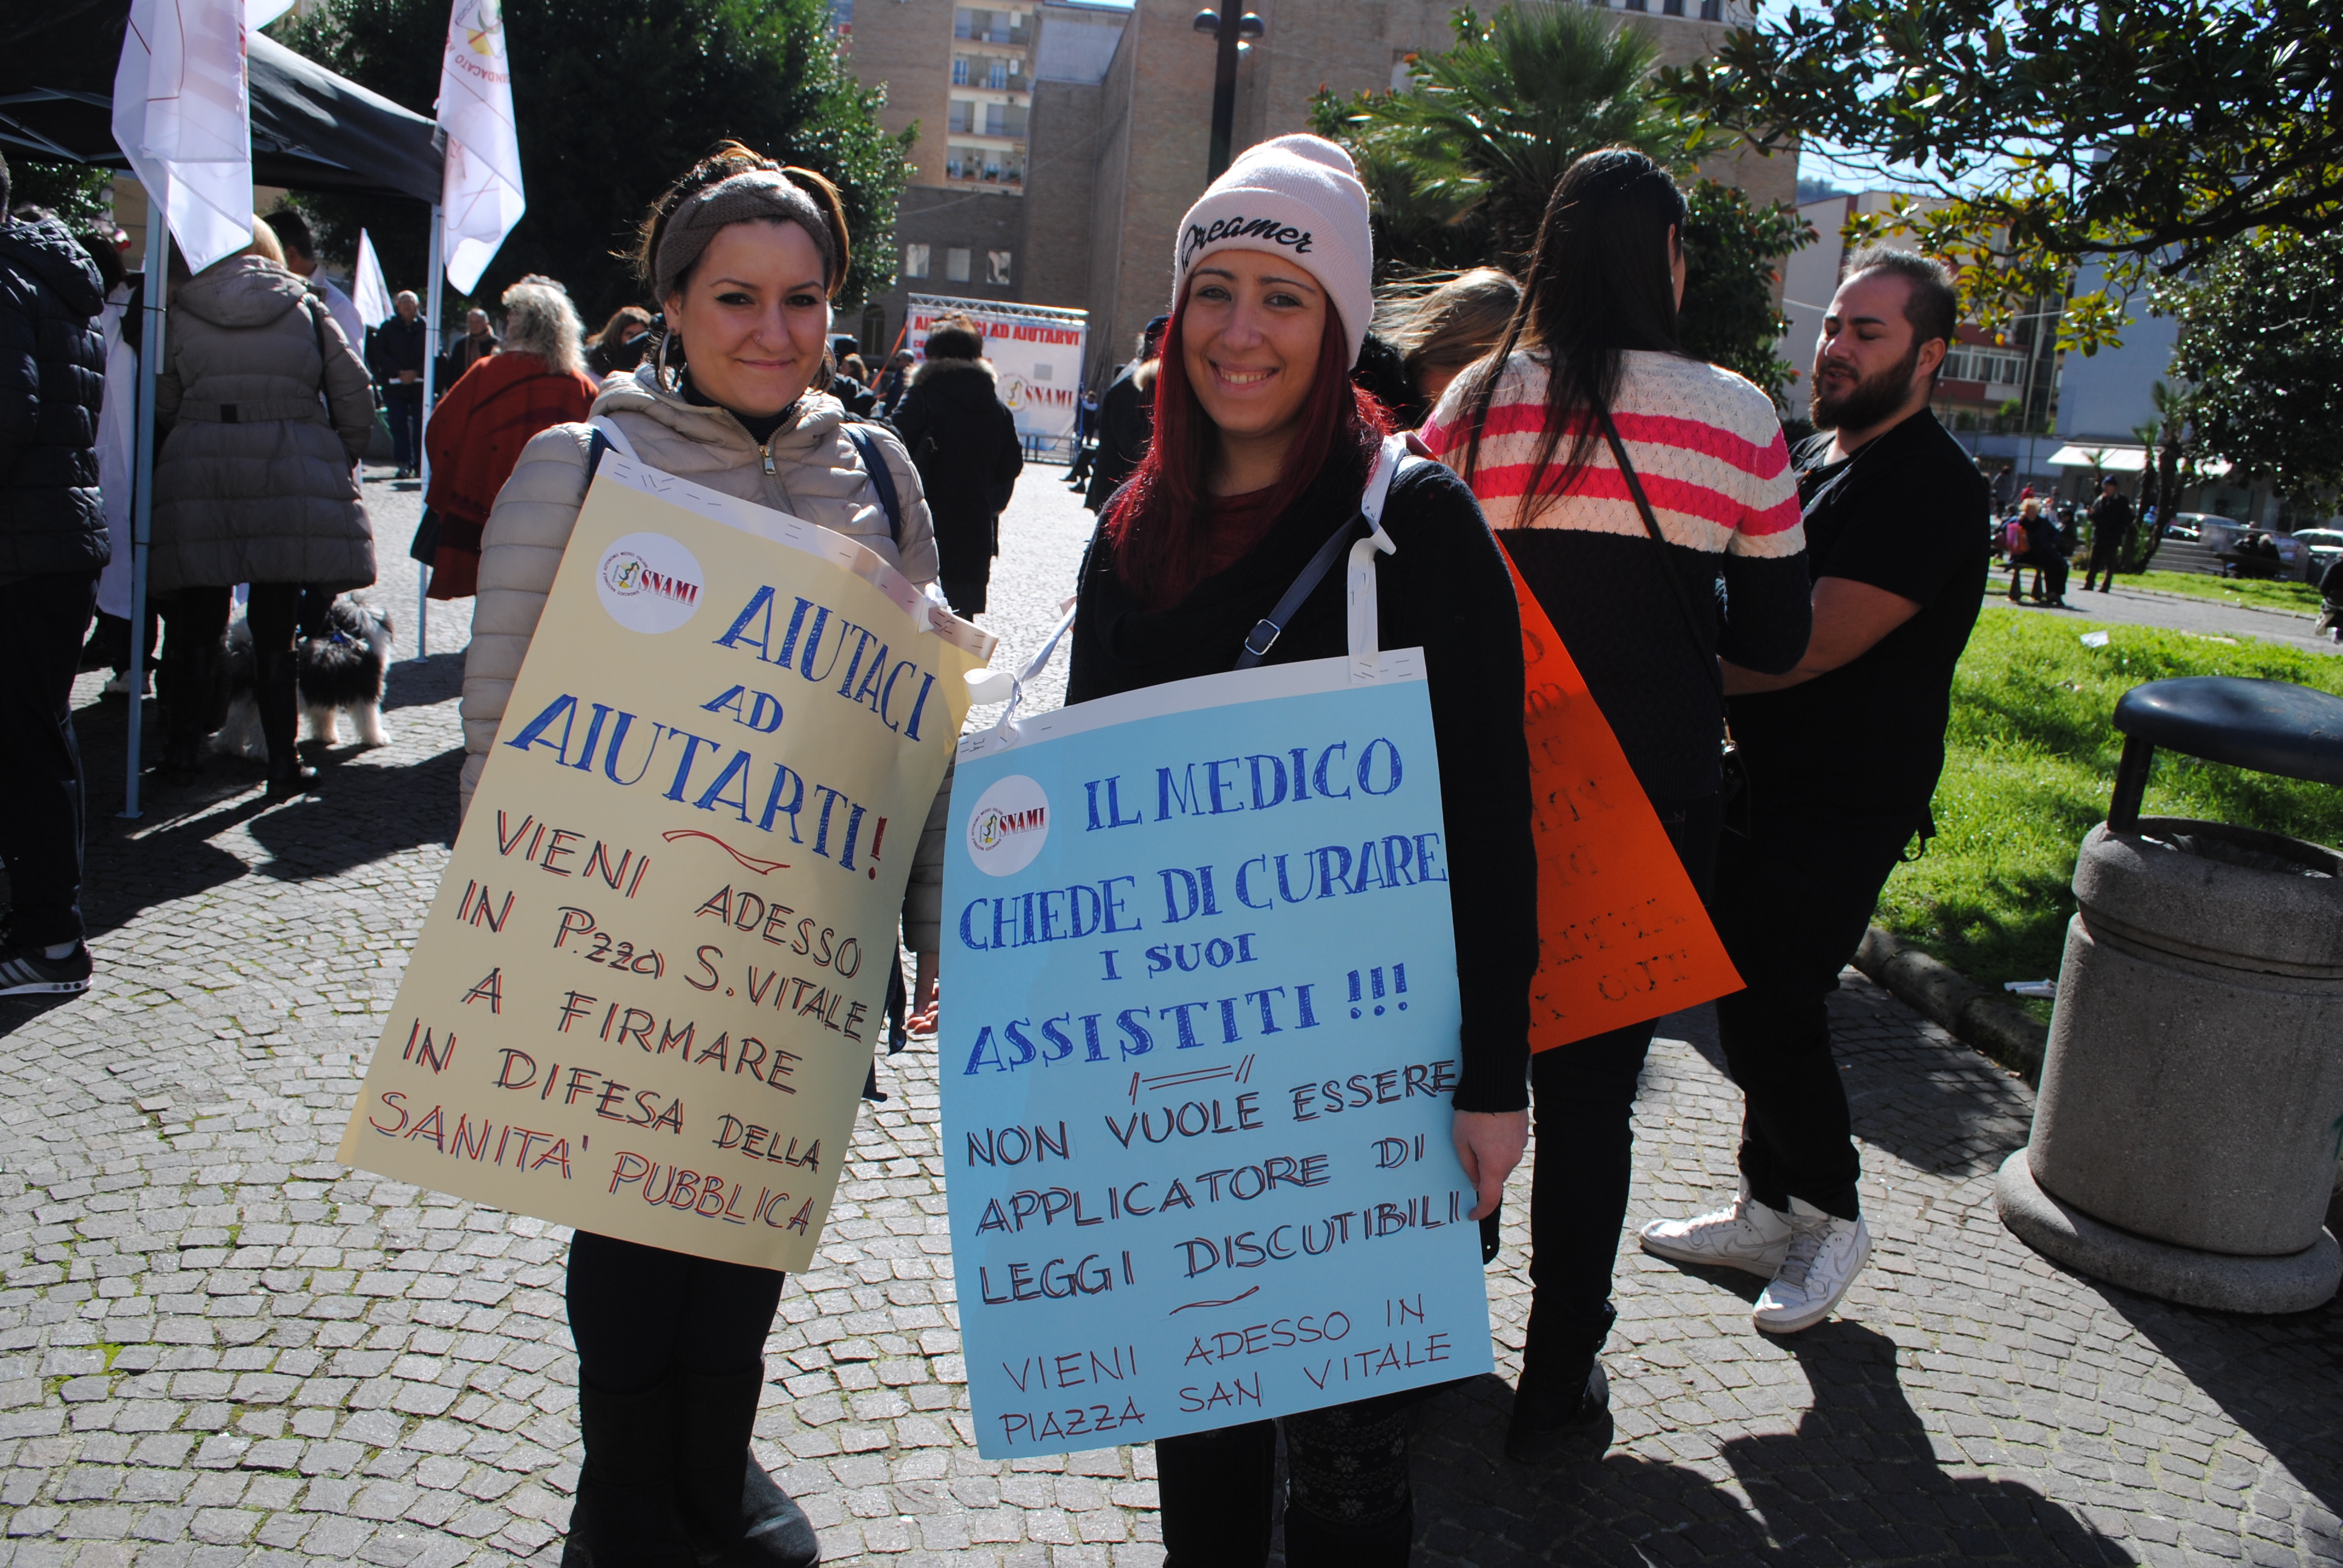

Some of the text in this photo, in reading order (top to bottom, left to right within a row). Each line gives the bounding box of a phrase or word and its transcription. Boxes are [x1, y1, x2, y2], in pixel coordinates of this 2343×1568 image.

[990, 322, 1010, 338] AD
[1013, 325, 1080, 346] AIUTARVI
[1025, 384, 1073, 409] SNAMI
[638, 569, 700, 607] SNAMI
[700, 684, 785, 734] AD
[712, 585, 936, 743] AIUTACI
[503, 693, 888, 881] AIUTARTI!
[999, 807, 1046, 837] SNAMI
[1084, 736, 1403, 832] IL MEDICO
[456, 878, 516, 933] IN
[497, 809, 862, 979] VIENI ADESSO
[959, 832, 1449, 952] CHIEDE DI CURARE
[1098, 932, 1259, 981] I SUOI
[460, 966, 803, 1095] A FIRMARE
[962, 983, 1321, 1076] ASSISTITI
[402, 1017, 821, 1174] IN DIFESA DELLA
[967, 1059, 1458, 1169] NON VUOLE ESSERE
[608, 1150, 815, 1237] PUBBLICA
[975, 1132, 1426, 1236] APPLICATORE DI
[978, 1190, 1461, 1305] LEGGI DISCUTIBILI
[998, 1331, 1453, 1445] PIAZZA SAN VITALE
[1001, 1292, 1426, 1394] VIENI ADESSO IN
